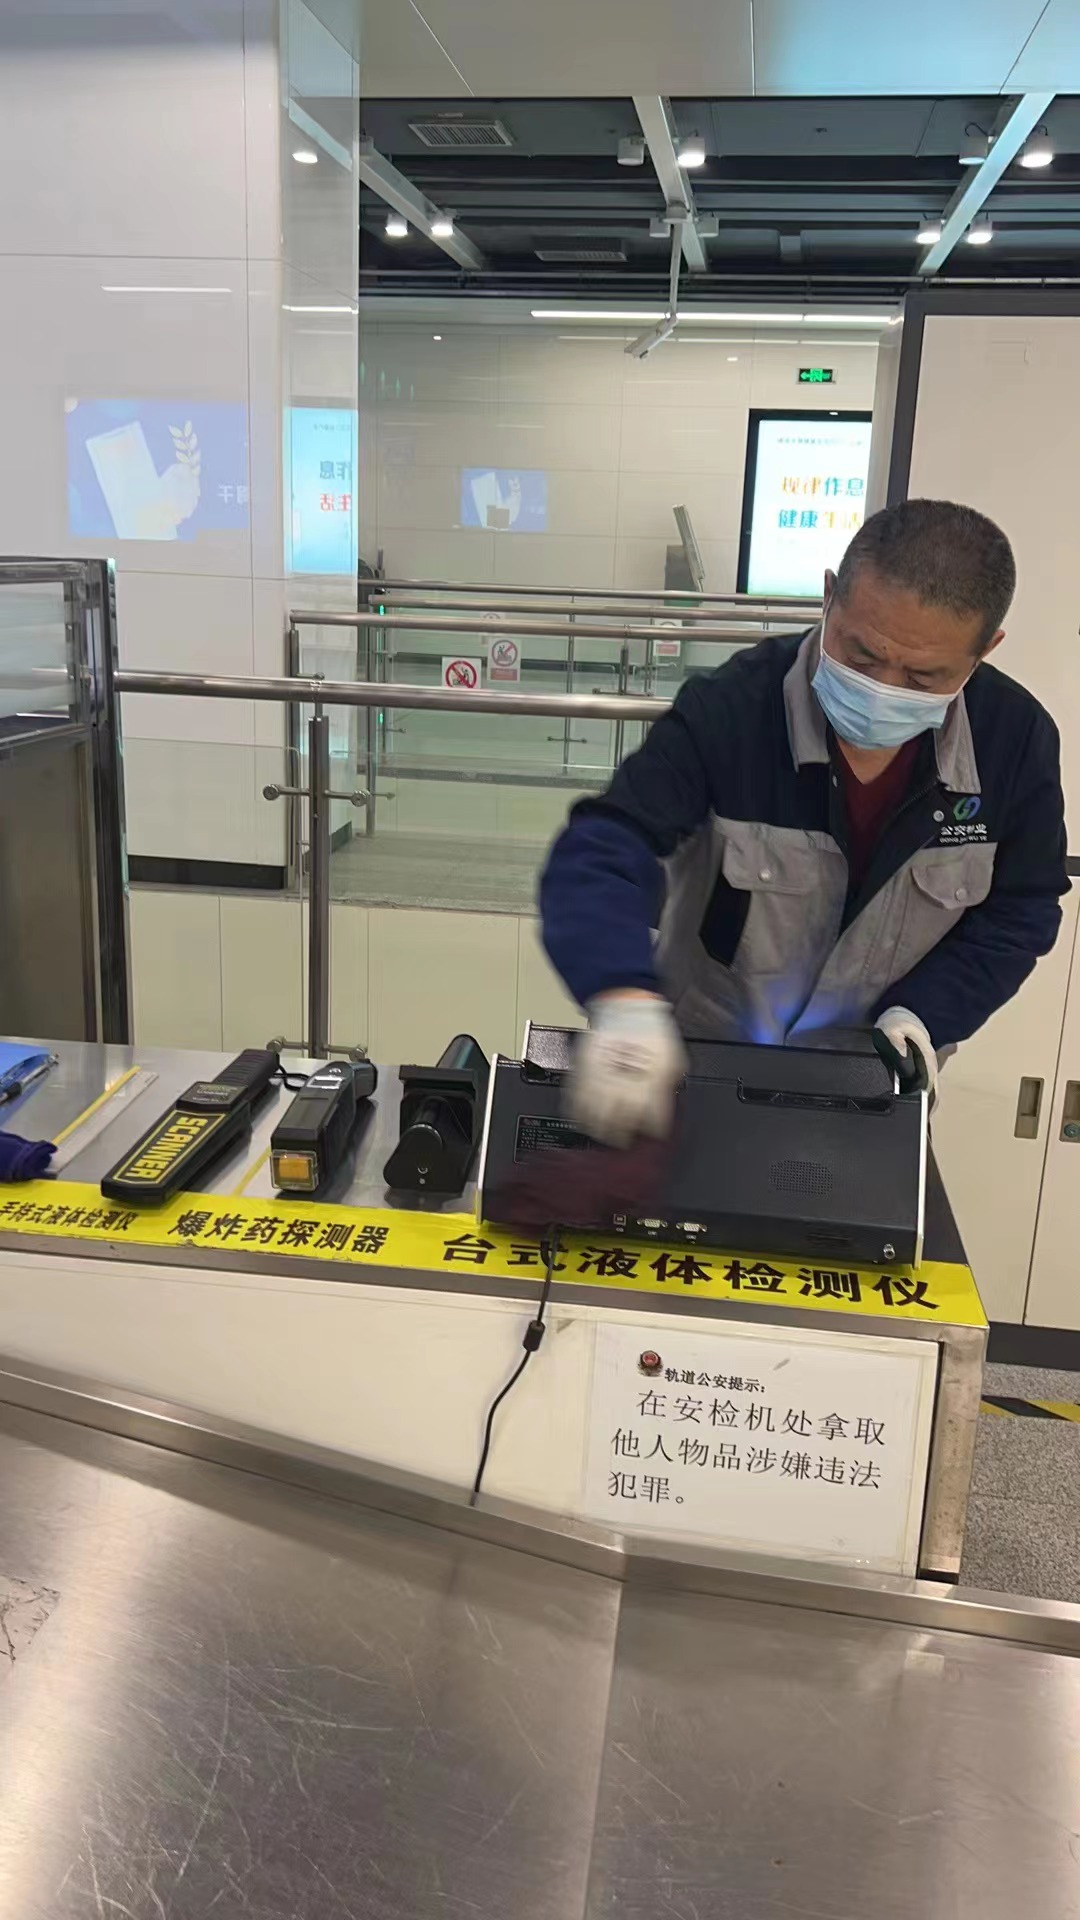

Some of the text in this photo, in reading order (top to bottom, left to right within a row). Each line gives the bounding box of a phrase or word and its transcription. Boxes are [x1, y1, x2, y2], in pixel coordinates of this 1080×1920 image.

[781, 476, 865, 497] 规律作息
[124, 1116, 208, 1180] SCANNER
[0, 1201, 139, 1232] 手持式液体检测仪
[167, 1209, 390, 1254] 爆炸药探测器
[442, 1233, 940, 1310] 台式液体检测仪
[636, 1389, 886, 1446] 在安检机处拿取
[610, 1427, 882, 1490] 他人物品涉嫌违法
[607, 1471, 685, 1505] 犯罪。
